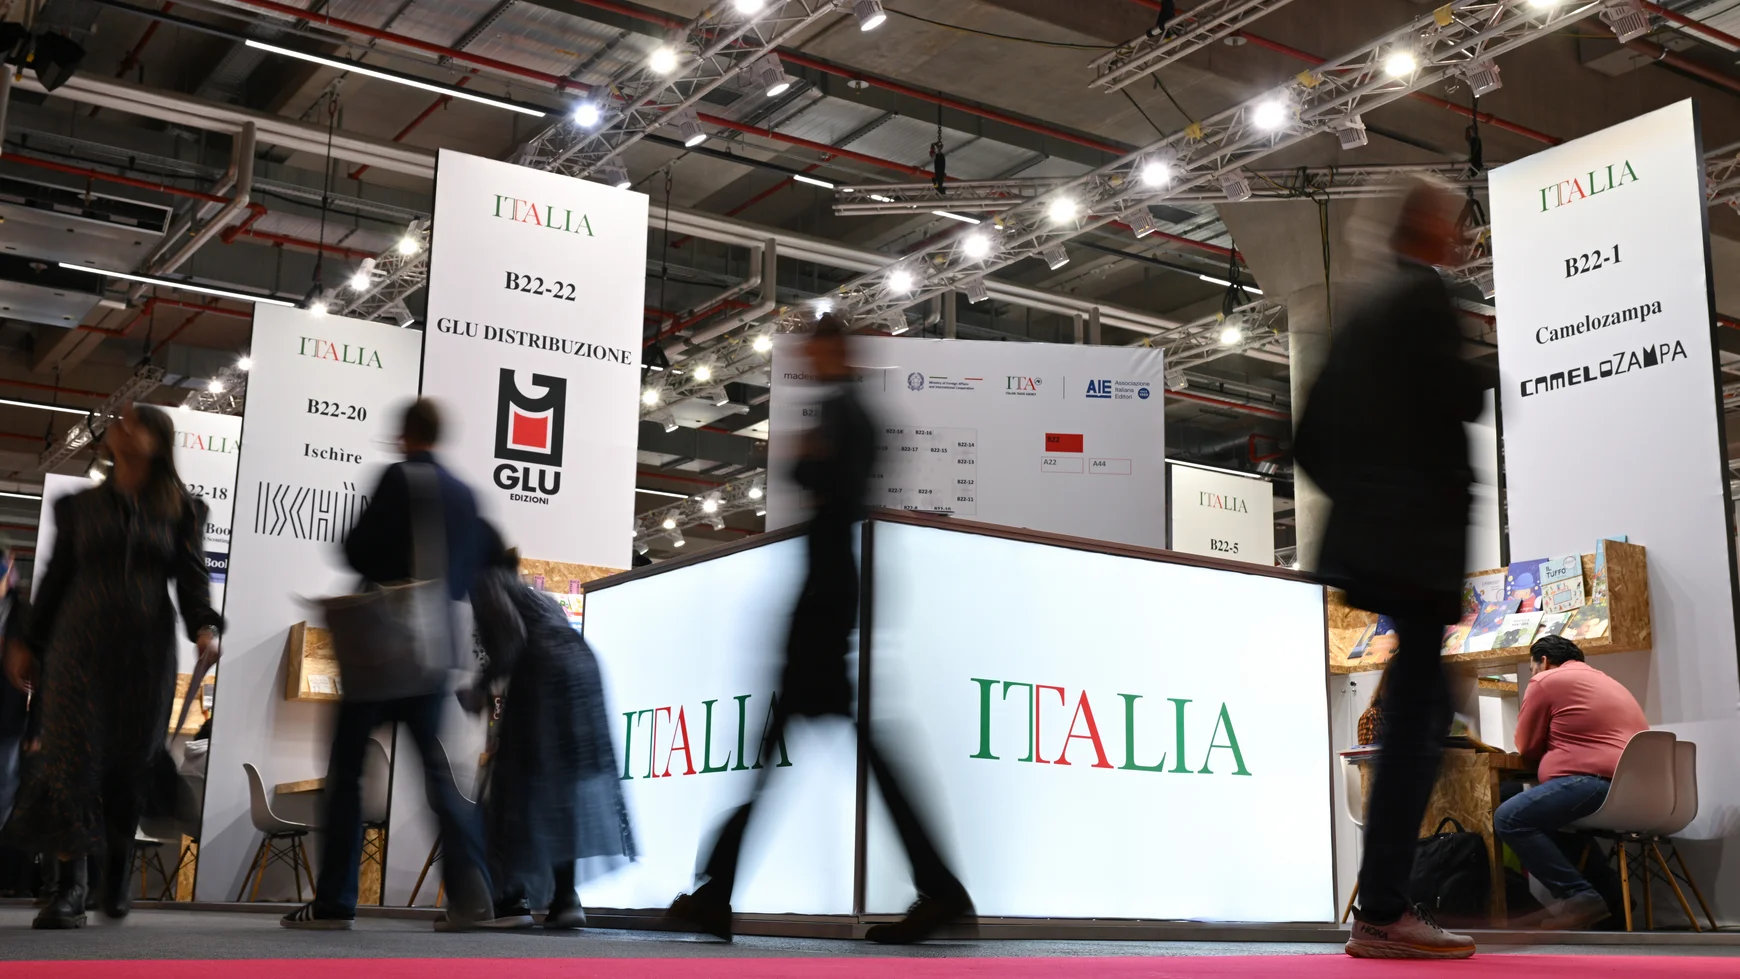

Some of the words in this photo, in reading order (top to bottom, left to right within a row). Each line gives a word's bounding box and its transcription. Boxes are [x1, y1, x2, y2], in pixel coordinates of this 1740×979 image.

[1539, 160, 1639, 212] ITALIA
[492, 194, 595, 237] ITALIA
[1564, 244, 1622, 278] B22-1
[504, 271, 577, 302] B22-22
[1535, 301, 1662, 345] Camelozampa
[298, 336, 383, 369] ITALIA
[436, 318, 478, 337] GLU
[483, 324, 632, 365] DISTRIBUZIONE
[1006, 376, 1036, 390] ITA
[1520, 340, 1688, 397] CAMELOZAMPA
[1086, 379, 1111, 394] AIE
[307, 398, 367, 422] B22-20
[303, 443, 362, 464] Ischìre
[187, 483, 228, 500] 22-18
[493, 463, 561, 495] GLU
[510, 493, 549, 505] EDIZIONI
[1199, 491, 1248, 514] ITALIA
[1210, 538, 1239, 554] B22-5
[1546, 568, 1566, 578] TUFFO
[619, 690, 793, 780] ITALIA
[969, 677, 1252, 776] ITALIA
[1360, 924, 1388, 940] HOKA
